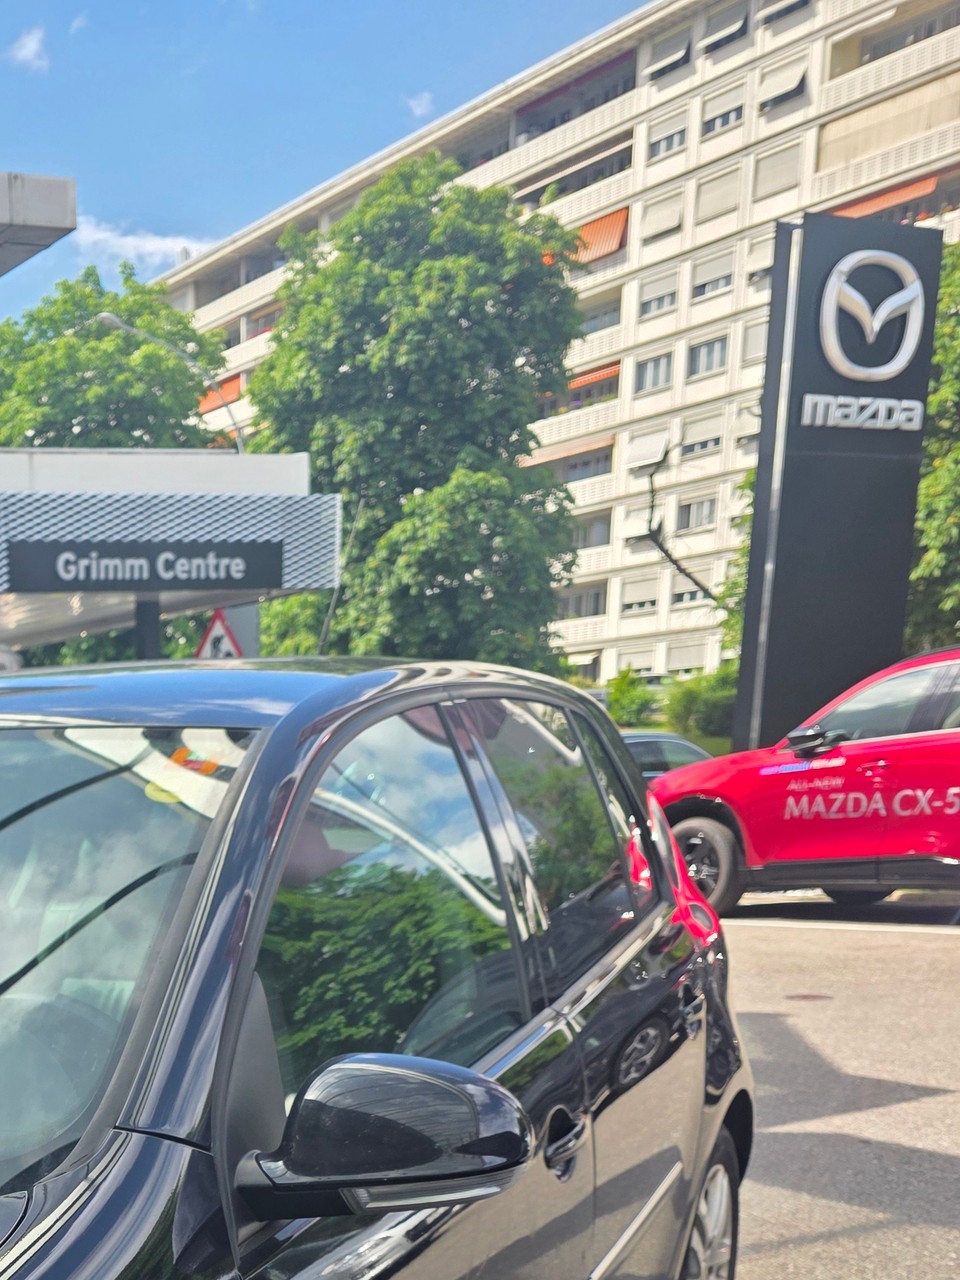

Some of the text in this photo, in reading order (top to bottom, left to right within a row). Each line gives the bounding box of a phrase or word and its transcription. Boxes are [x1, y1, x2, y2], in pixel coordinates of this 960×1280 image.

[801, 393, 925, 431] mazda
[56, 550, 246, 581] Grimm Centre
[784, 786, 960, 820] MAZDA CX-5
